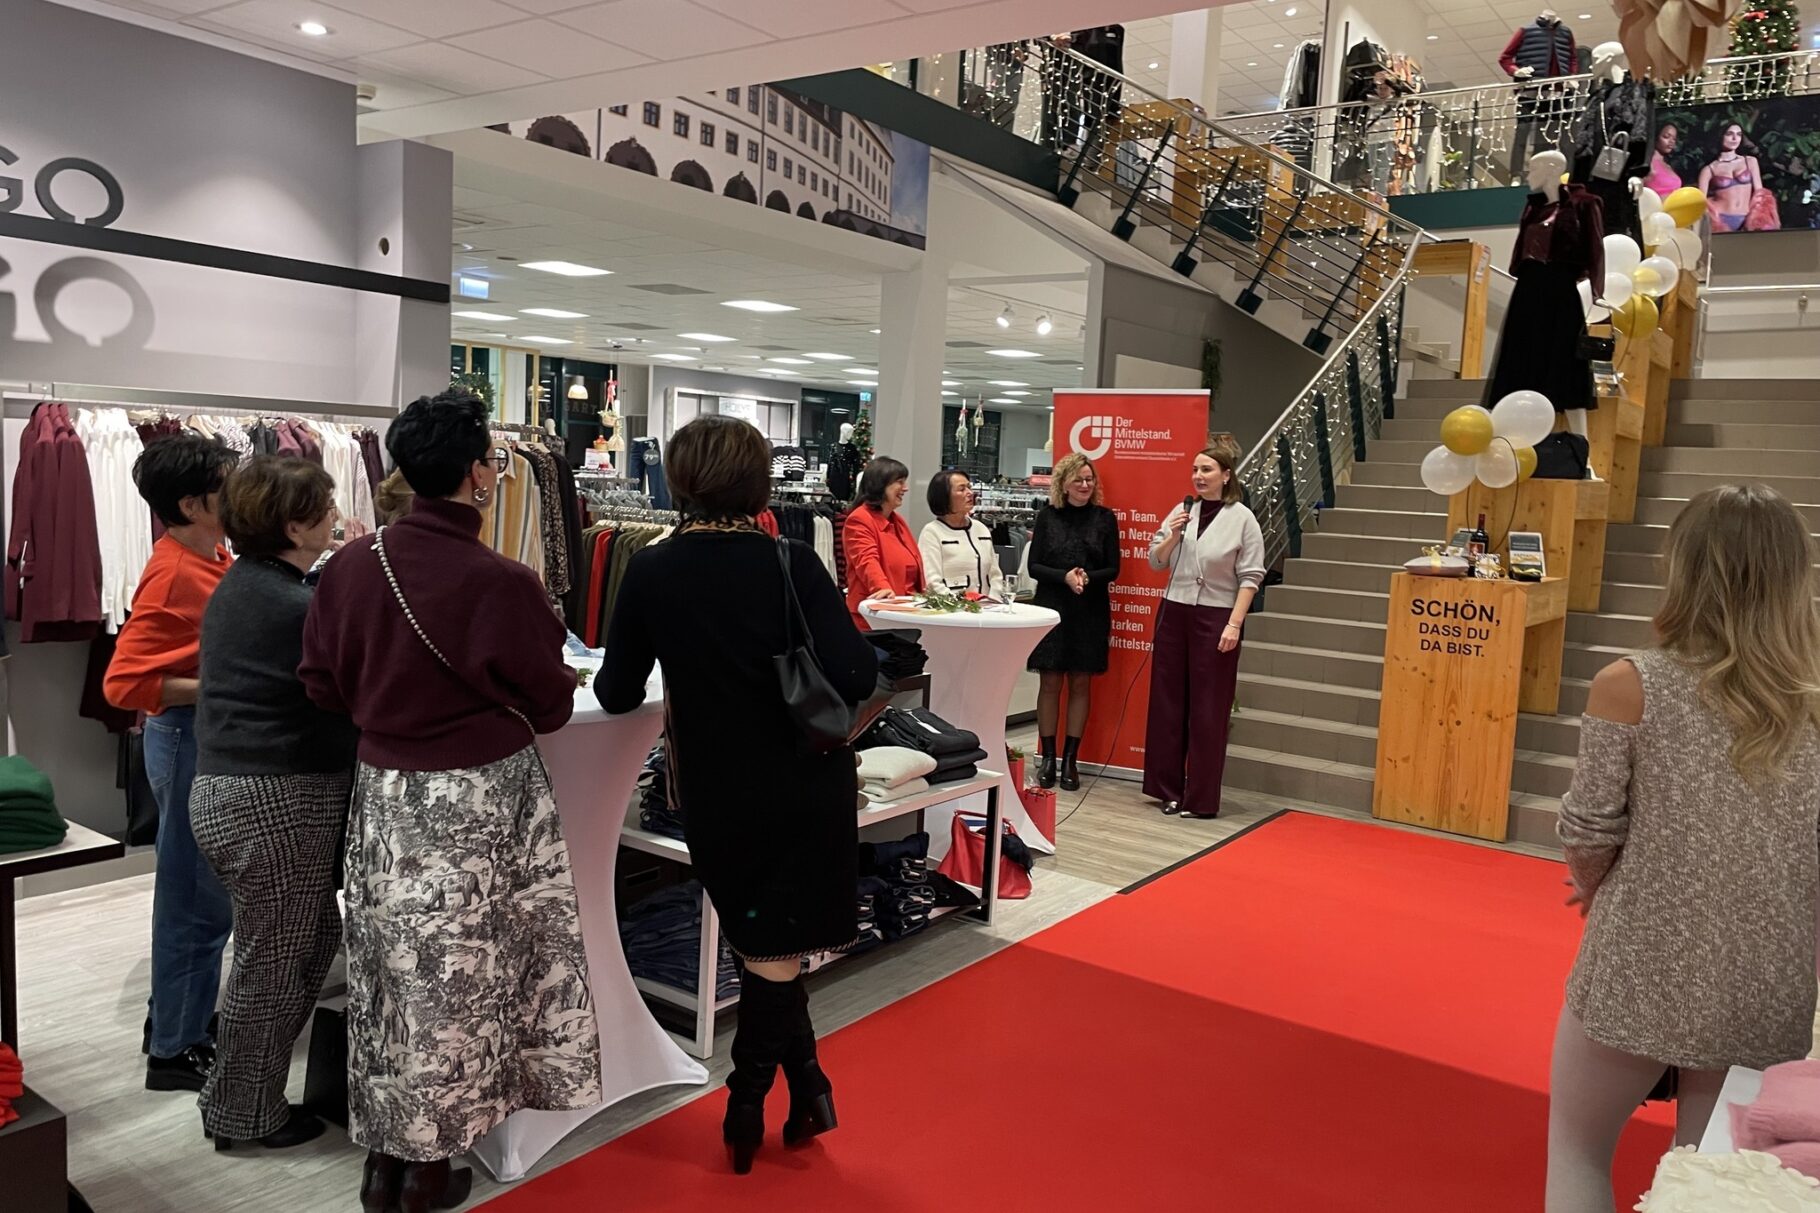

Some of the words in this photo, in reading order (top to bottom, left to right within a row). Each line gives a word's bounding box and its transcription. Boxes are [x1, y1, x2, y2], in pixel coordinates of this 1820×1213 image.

[1115, 416, 1133, 427] Der
[1115, 428, 1172, 440] Mittelstand.
[1114, 438, 1146, 449] BVMW
[1129, 509, 1159, 523] Team.
[1129, 528, 1154, 542] Netz
[1110, 600, 1121, 612] ür
[1124, 601, 1151, 615] einen
[1411, 598, 1500, 627] SCHÖN,
[1112, 619, 1144, 632] tarken
[1419, 622, 1462, 638] DASS
[1467, 627, 1490, 641] DU
[1420, 639, 1442, 653] DA
[1447, 642, 1485, 658] BIST.
